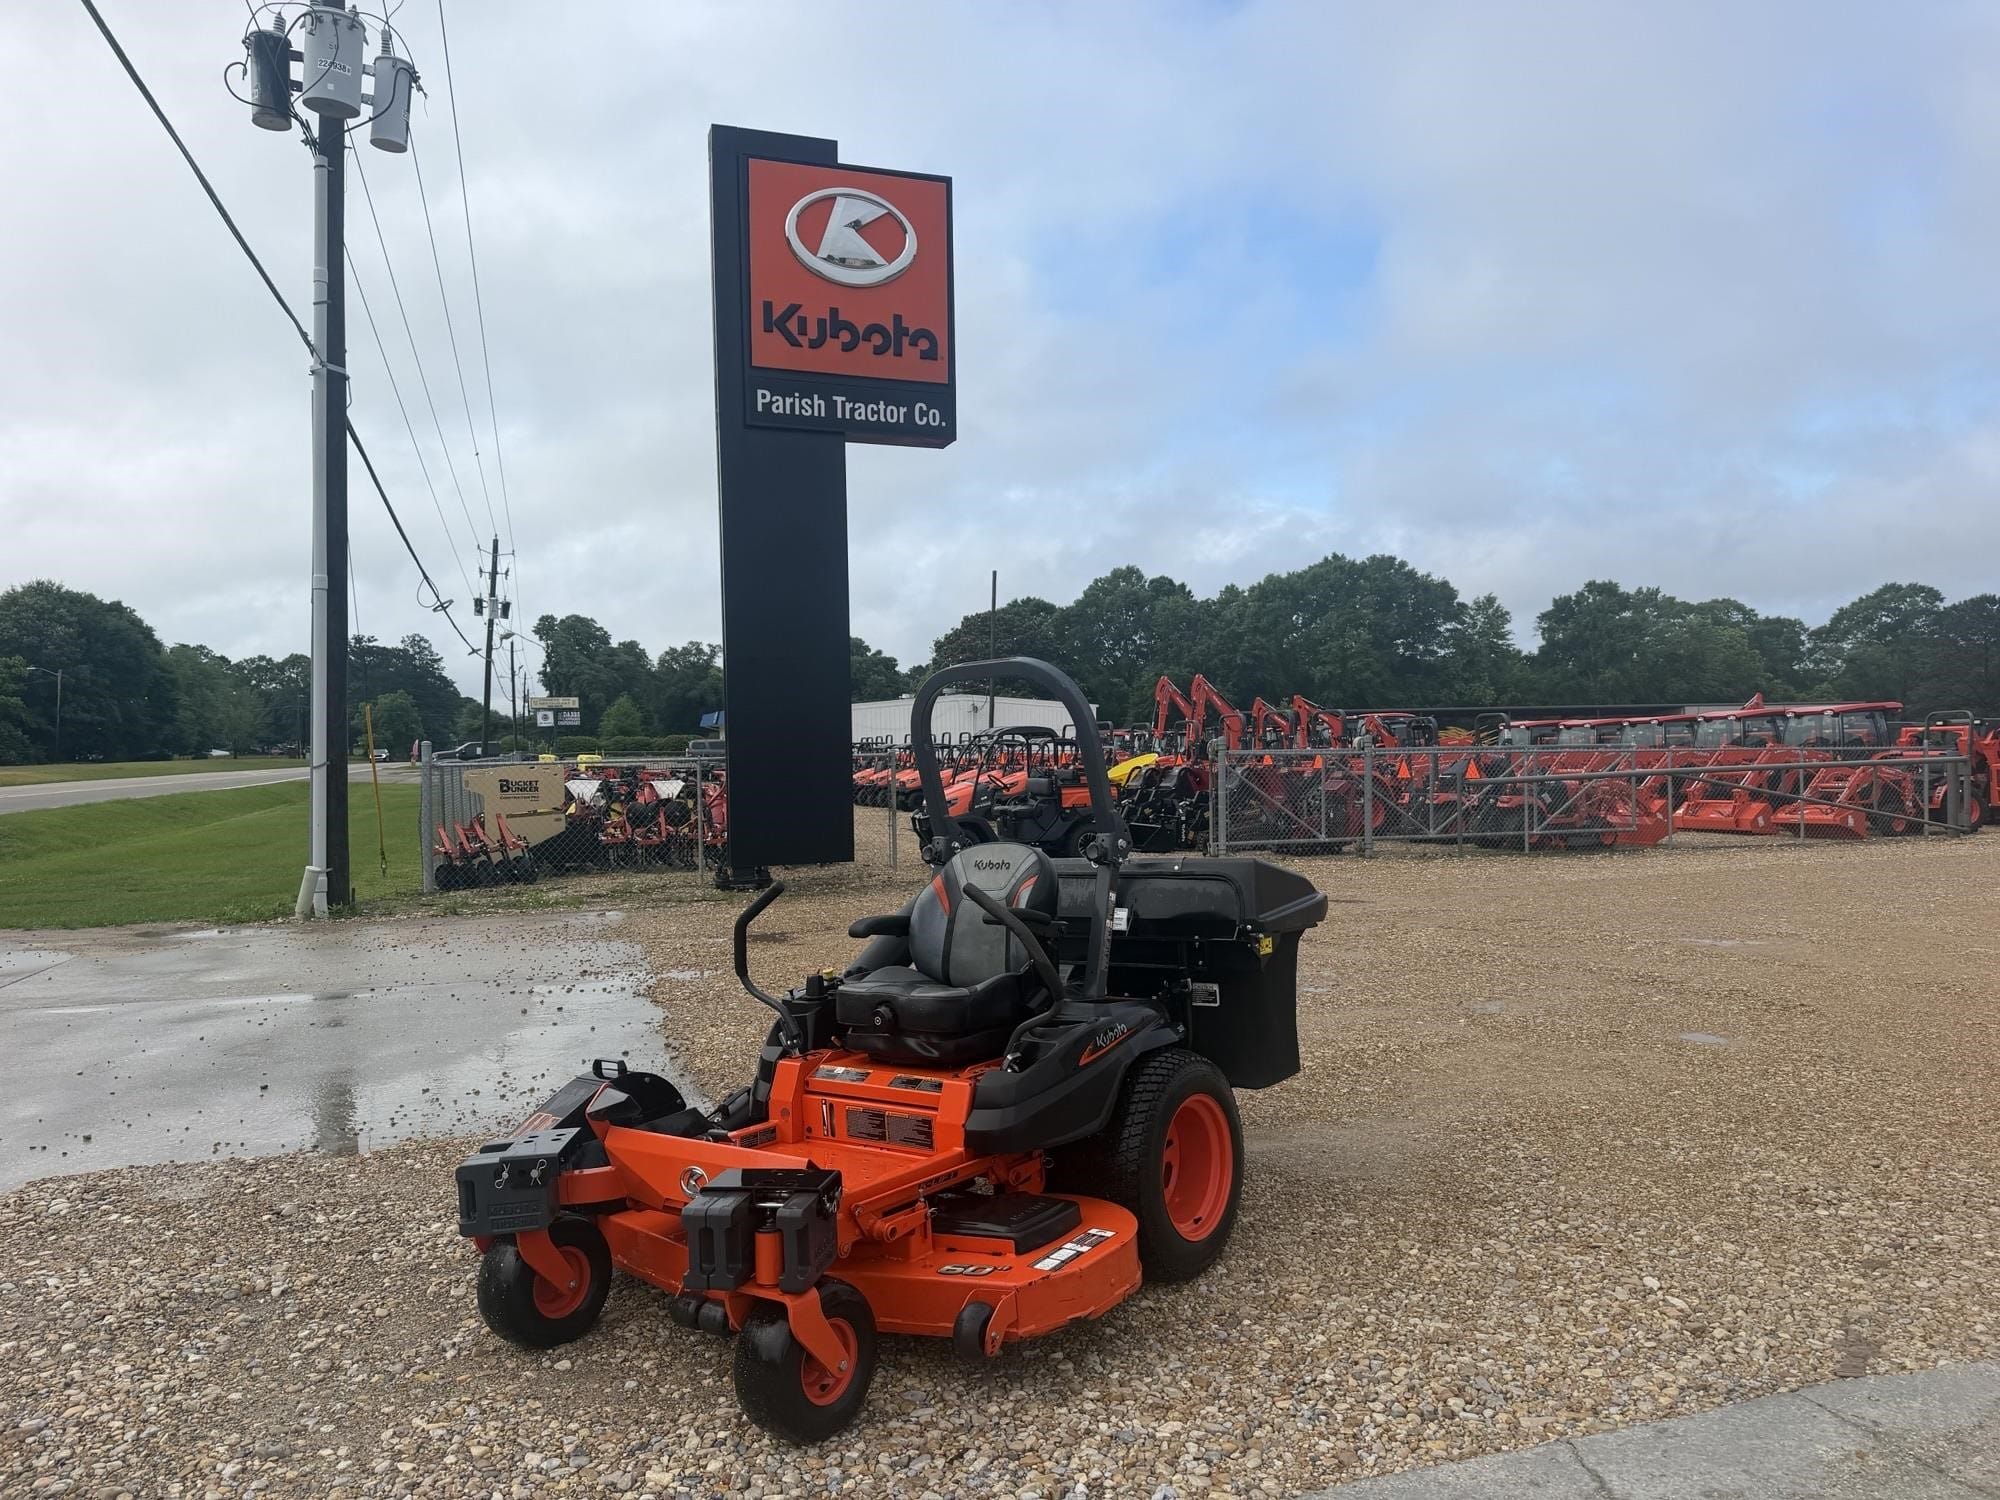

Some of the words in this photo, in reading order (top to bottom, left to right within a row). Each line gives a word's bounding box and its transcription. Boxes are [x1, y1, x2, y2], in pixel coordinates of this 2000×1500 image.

[763, 300, 938, 361] Kubota
[756, 389, 825, 417] Parish
[832, 396, 907, 424] Tractor
[914, 402, 946, 427] Co.
[974, 859, 1011, 871] Kubota
[1096, 1023, 1127, 1047] Kubota
